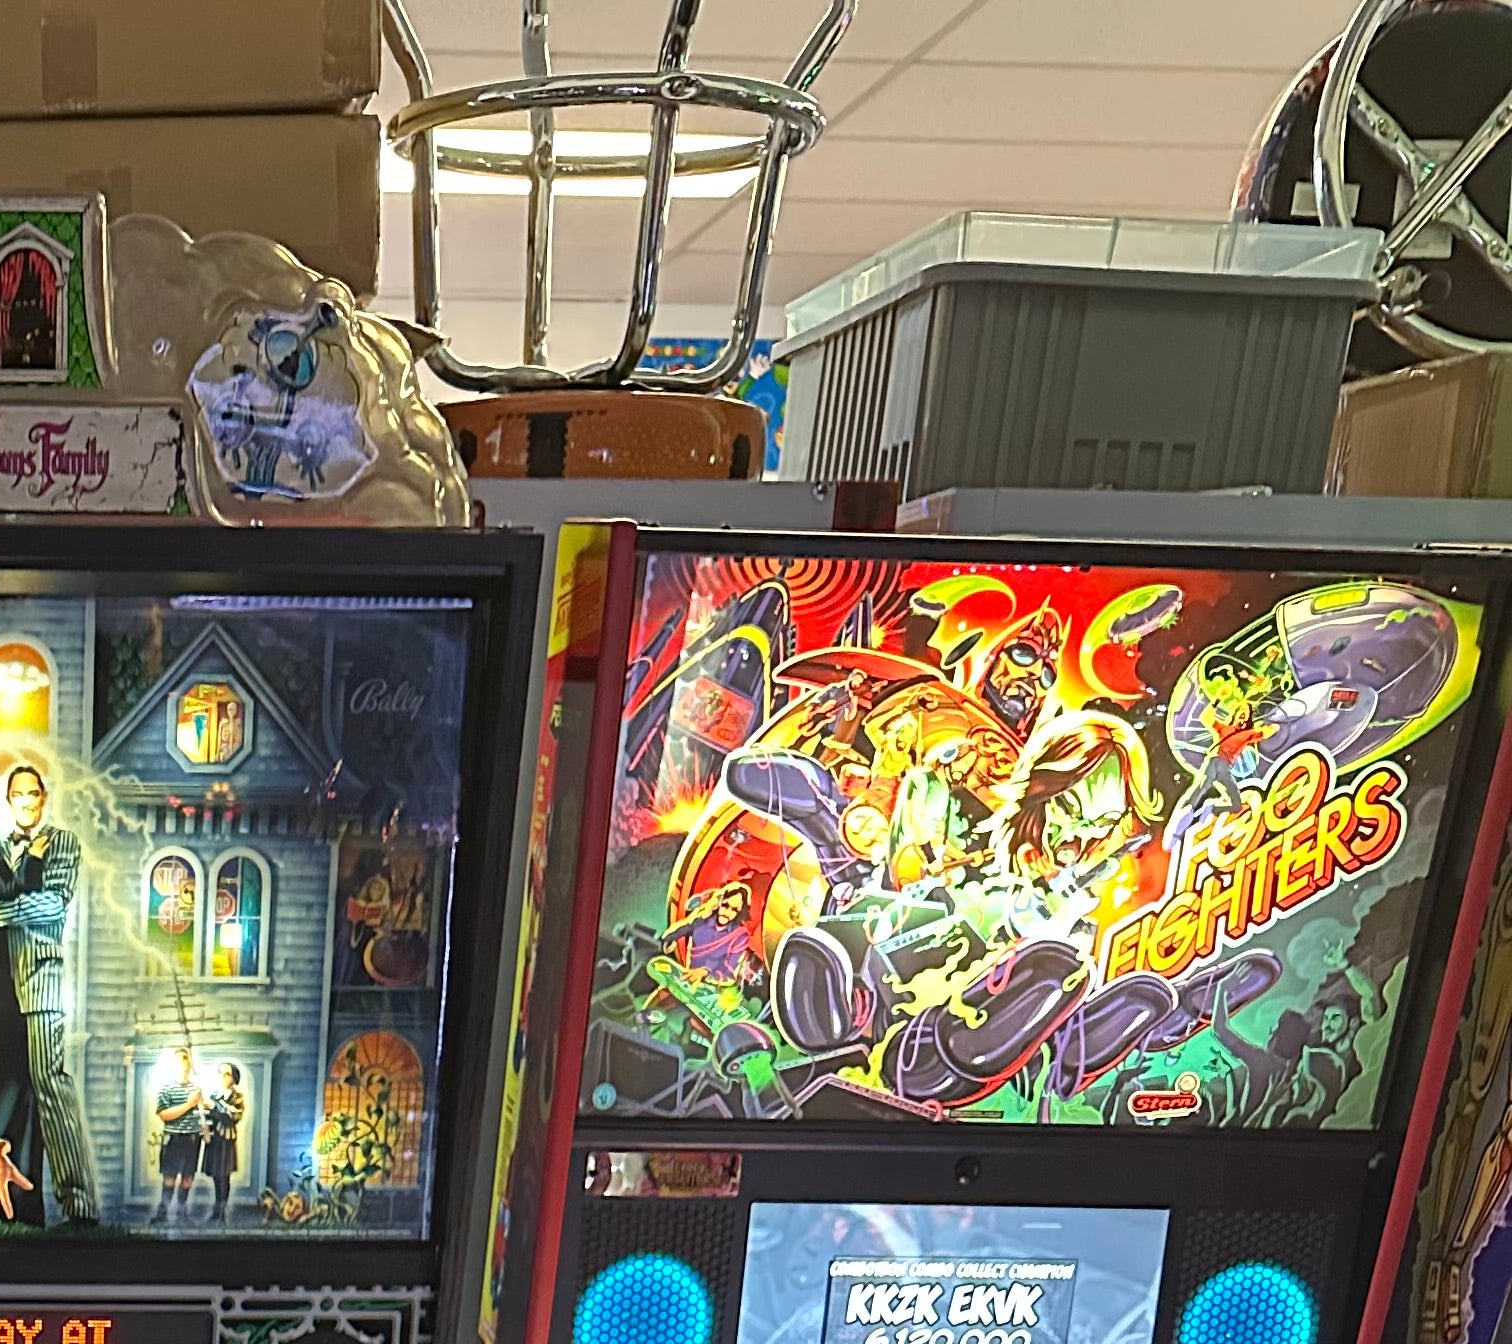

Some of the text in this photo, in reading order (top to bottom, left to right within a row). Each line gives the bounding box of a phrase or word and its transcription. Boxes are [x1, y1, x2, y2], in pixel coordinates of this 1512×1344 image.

[28, 414, 110, 497] Family
[350, 679, 425, 721] Bally
[1177, 746, 1330, 895] FOO
[1104, 768, 1404, 983] FIGHTERS
[1135, 1095, 1196, 1112] Stern
[956, 1262, 1009, 1279] COLLECT
[845, 1282, 944, 1326] KKZK
